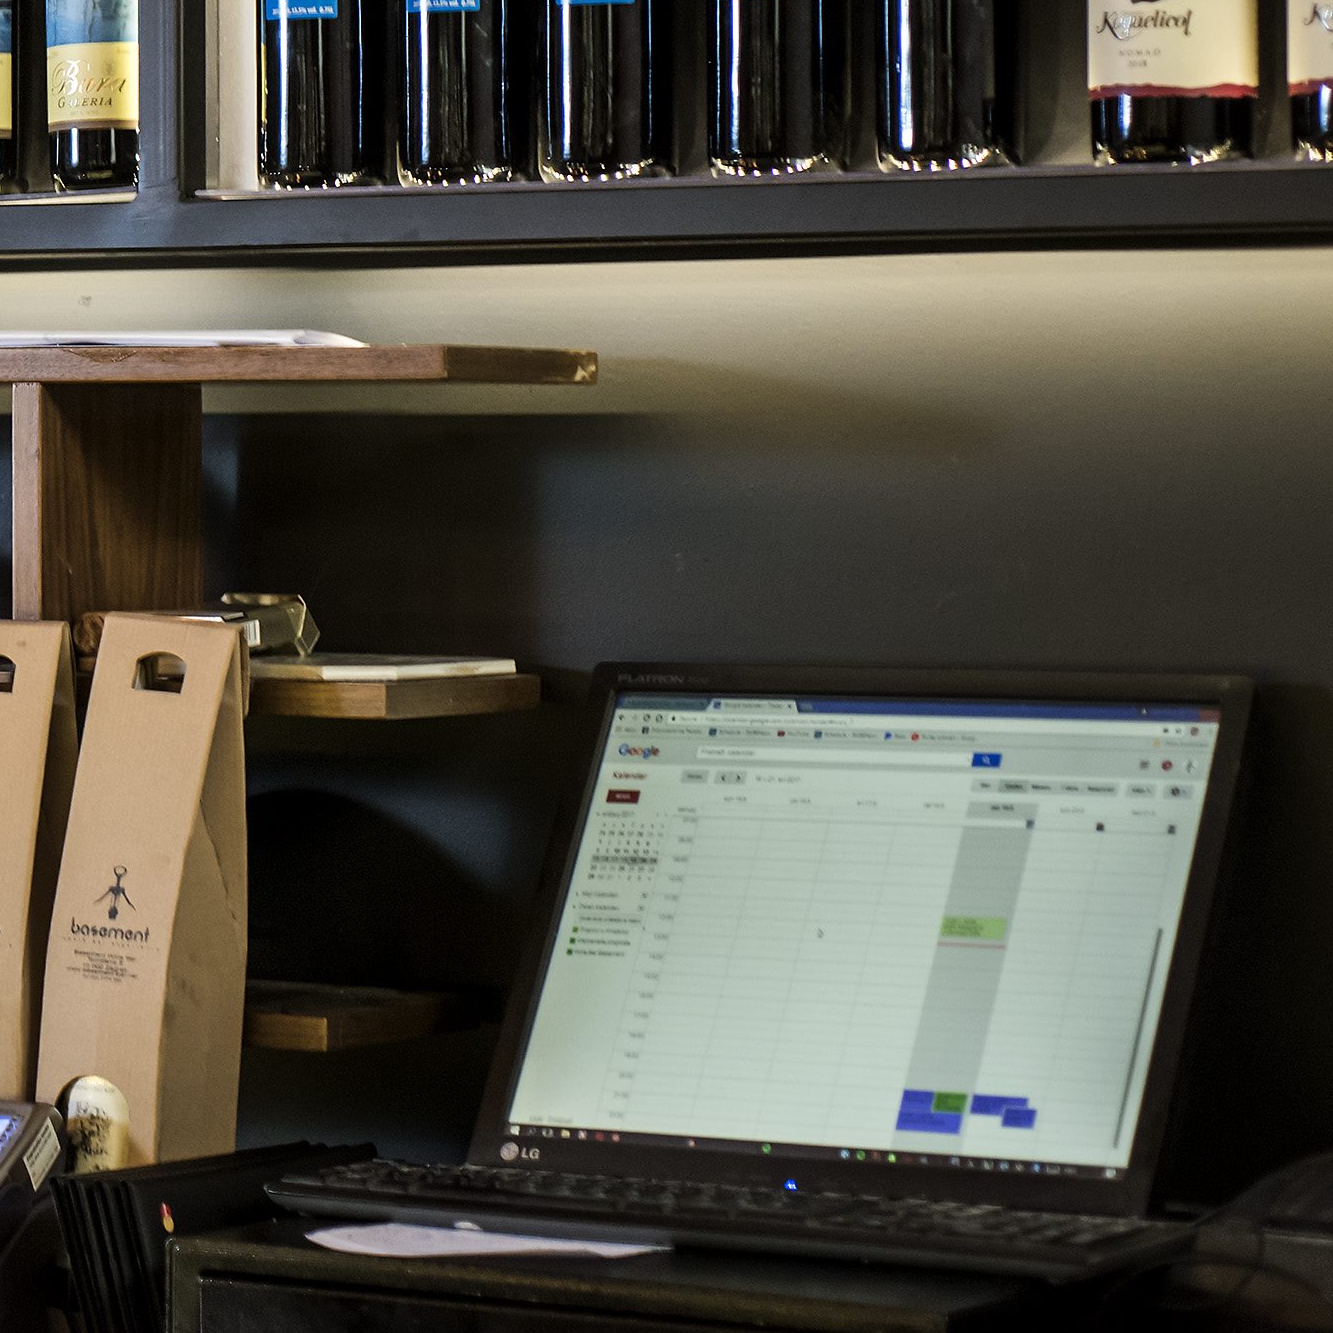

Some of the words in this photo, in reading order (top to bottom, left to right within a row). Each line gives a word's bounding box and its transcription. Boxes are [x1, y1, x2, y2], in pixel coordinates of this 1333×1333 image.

[618, 743, 661, 760] Google
[70, 916, 150, 943] basement
[520, 1146, 541, 1160] LG
